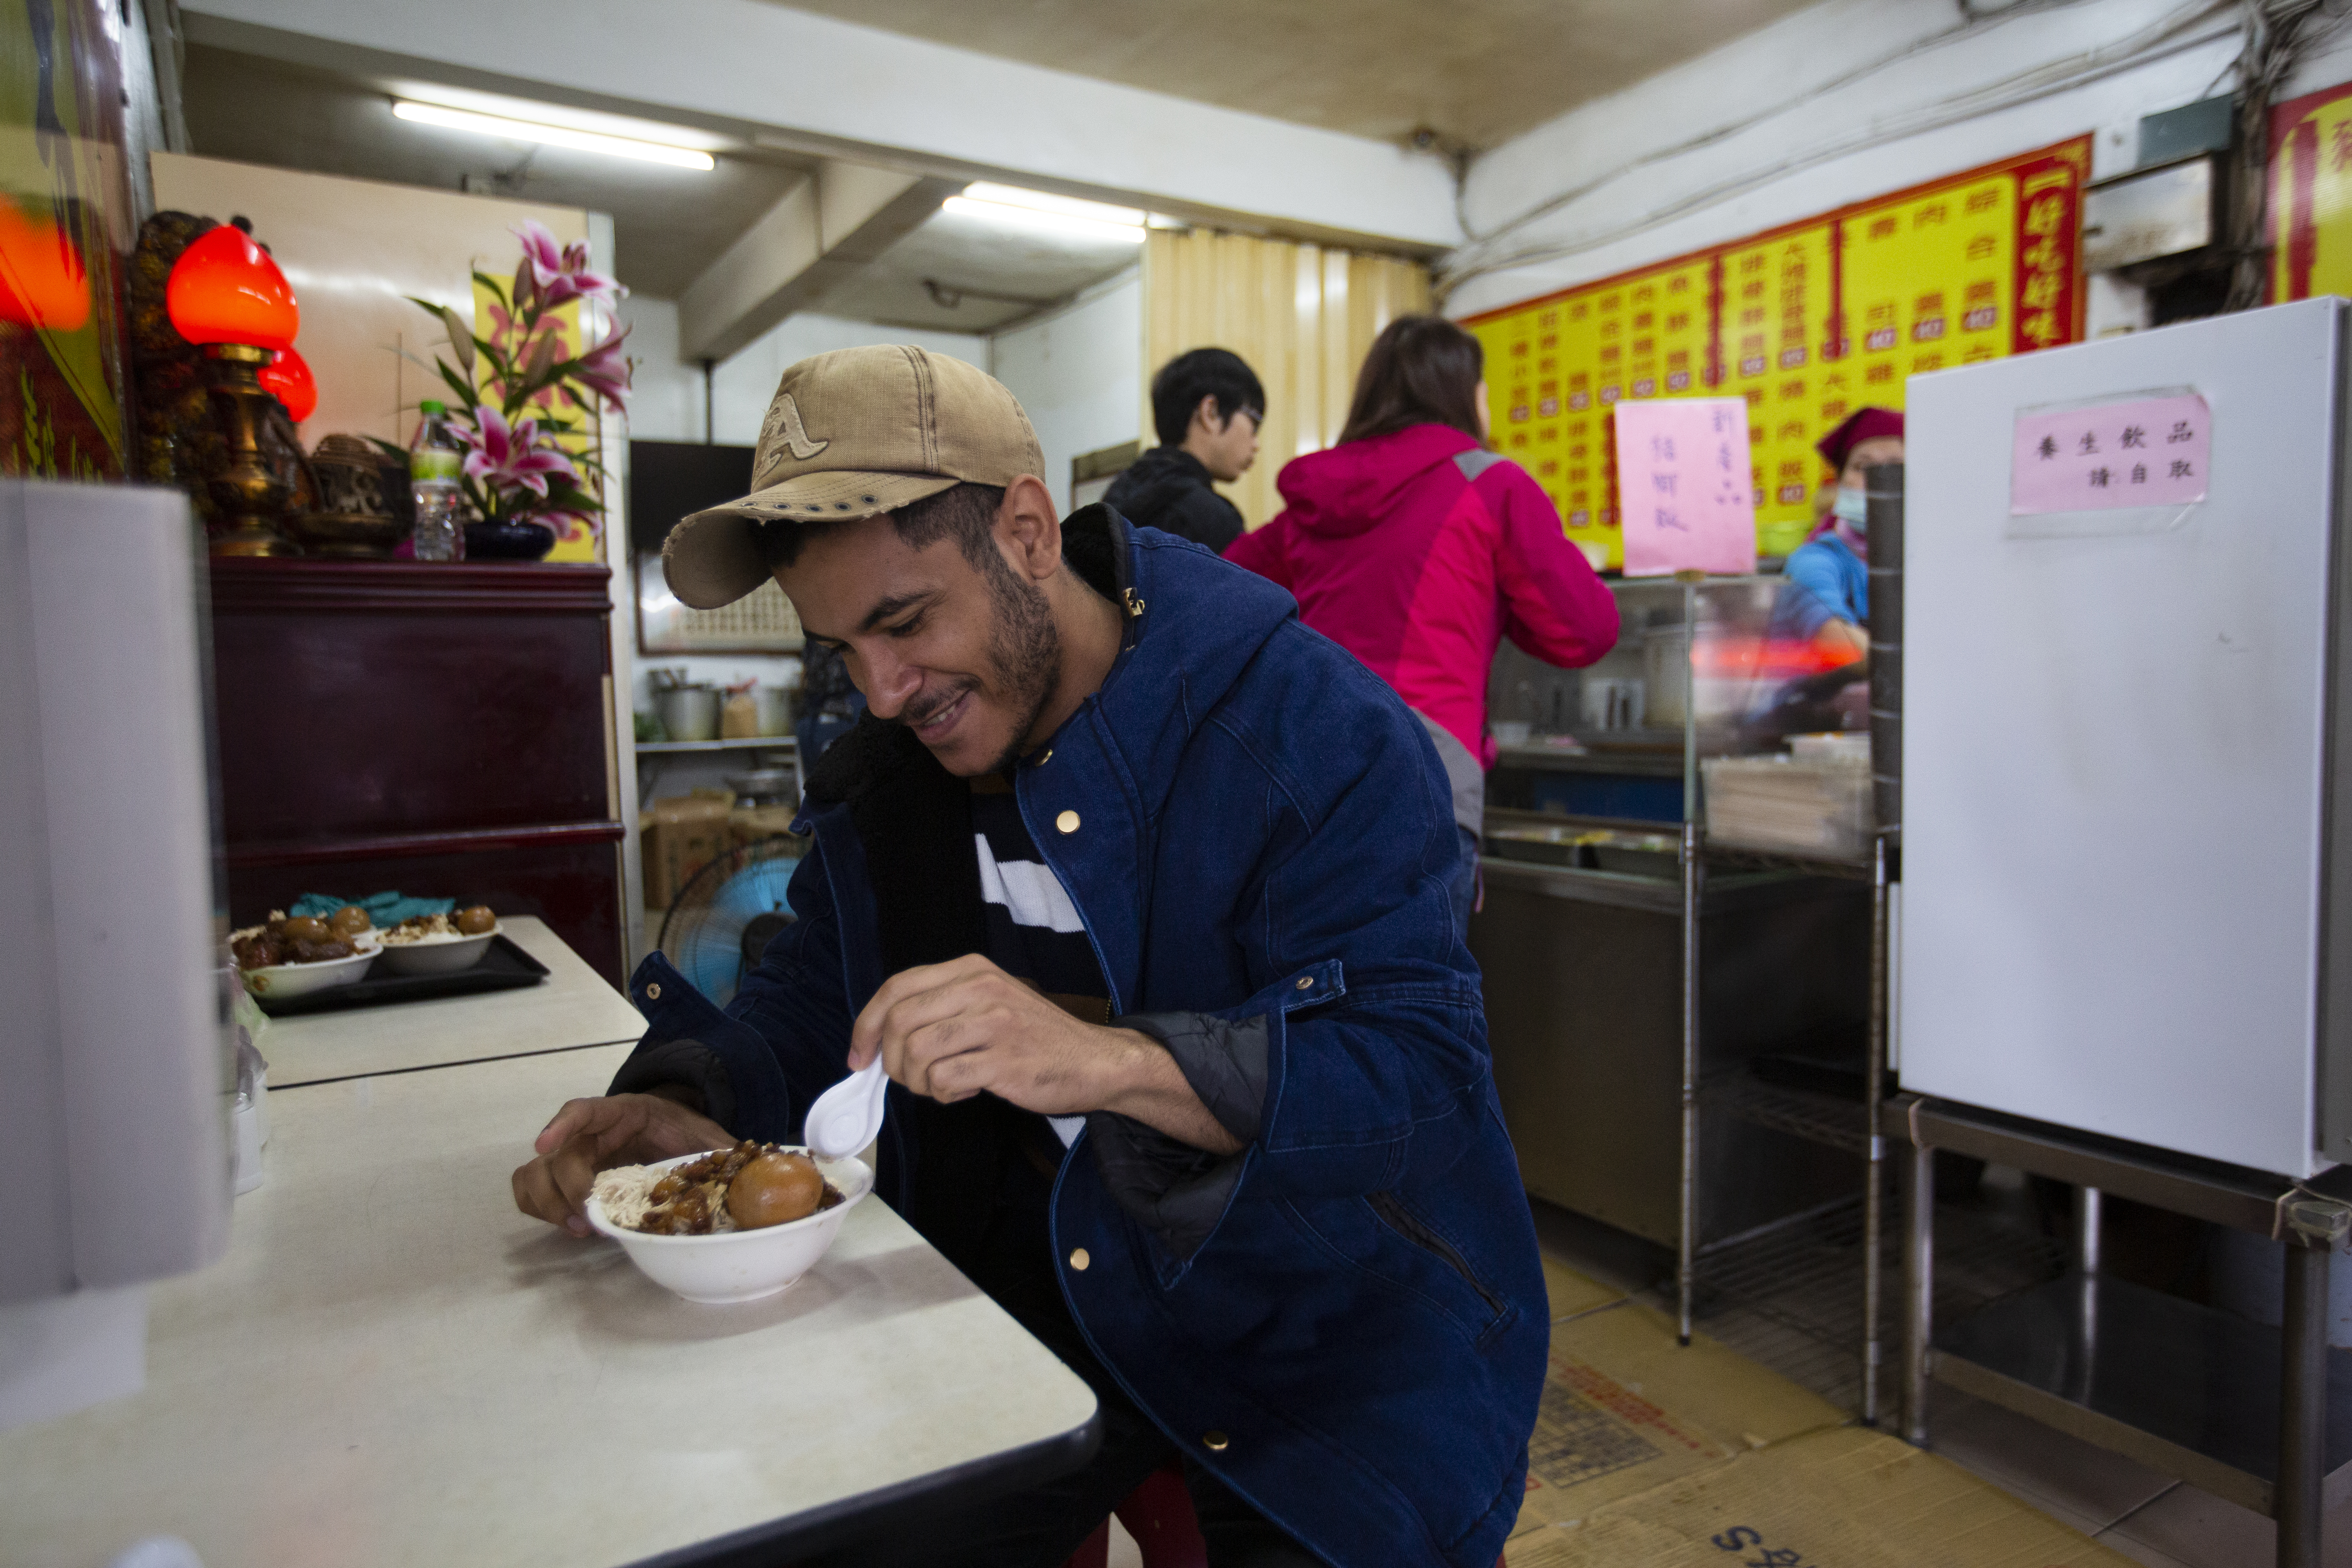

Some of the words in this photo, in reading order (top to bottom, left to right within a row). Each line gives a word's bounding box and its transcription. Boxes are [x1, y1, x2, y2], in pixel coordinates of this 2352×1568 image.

[752, 393, 828, 482] A
[2087, 459, 2194, 488] 請自取
